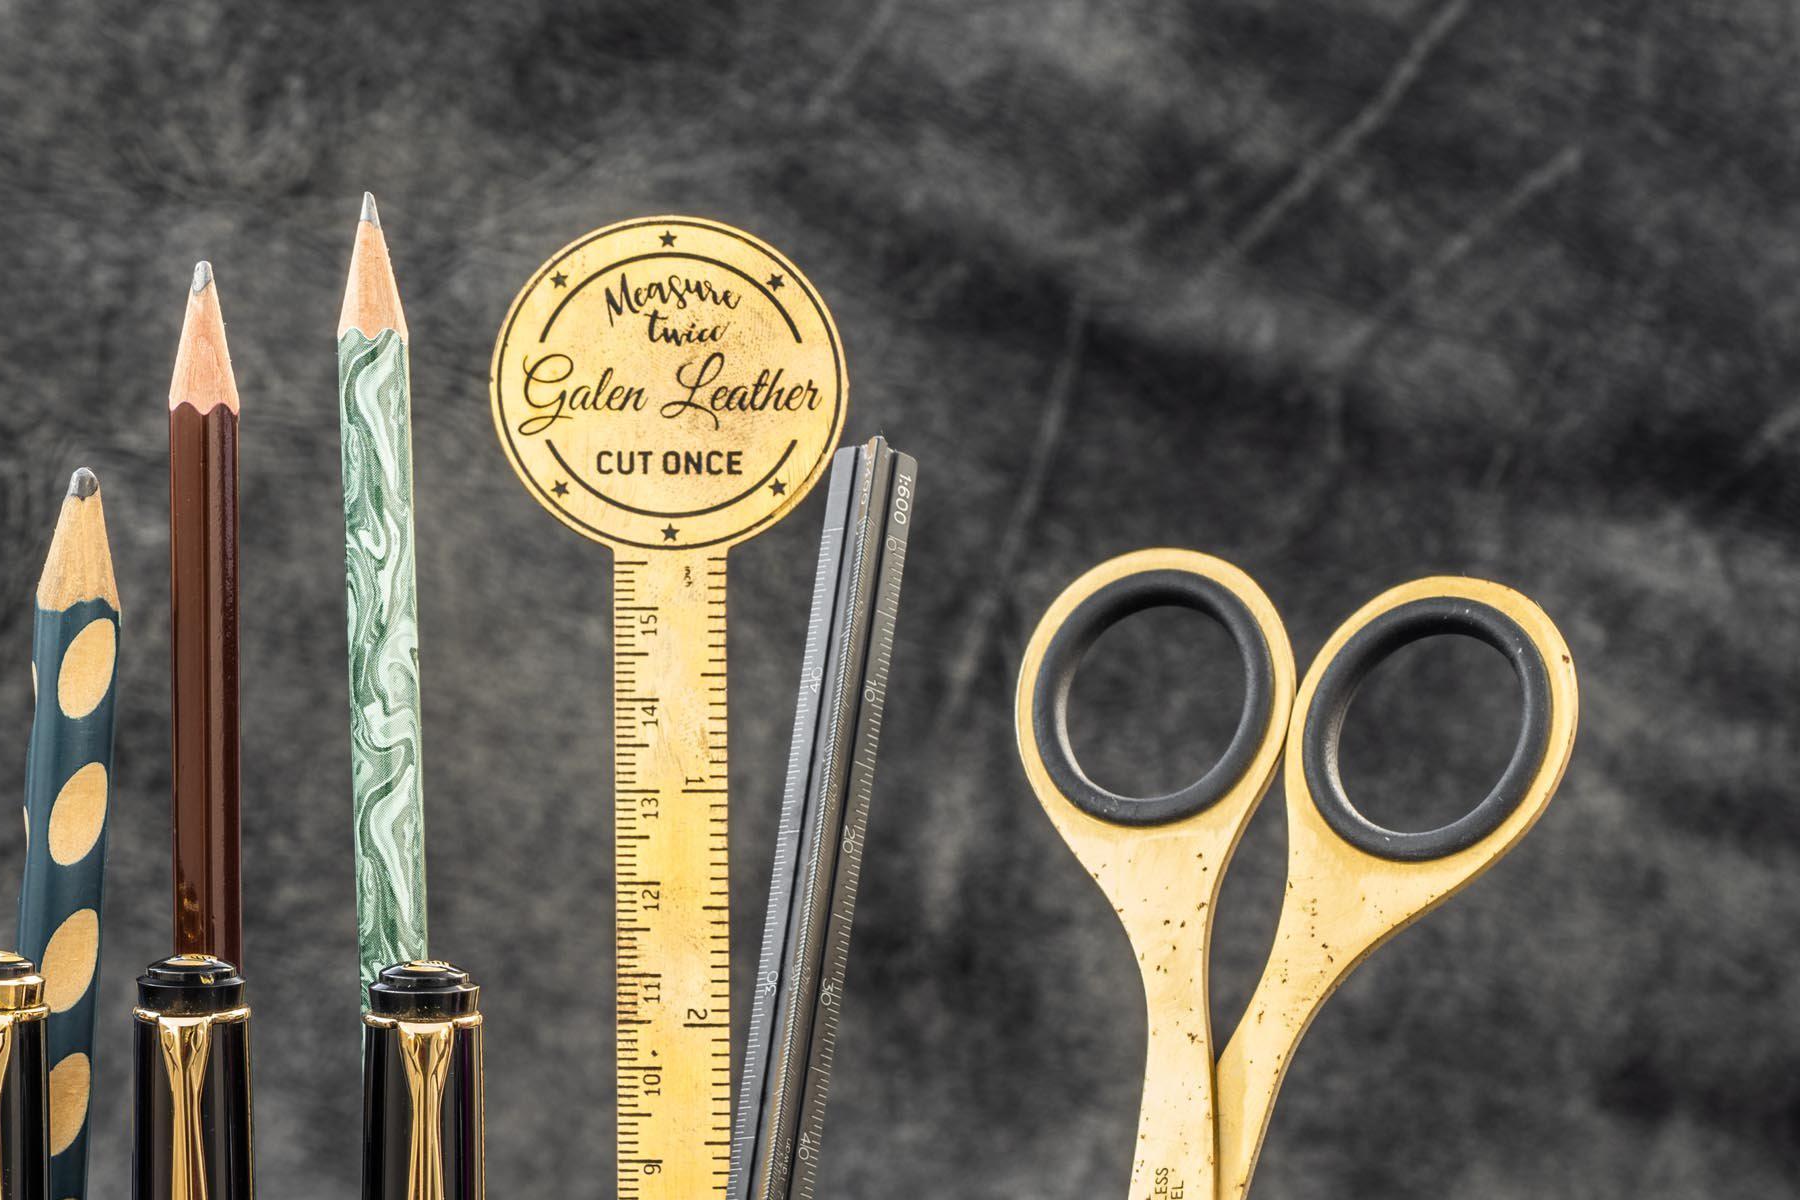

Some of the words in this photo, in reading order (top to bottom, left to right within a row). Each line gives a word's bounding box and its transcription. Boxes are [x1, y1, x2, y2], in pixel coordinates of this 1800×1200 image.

[604, 272, 742, 328] Measure
[643, 309, 731, 347] twice
[517, 353, 649, 437] Galen
[660, 351, 822, 431] Leather
[596, 450, 653, 475] CUT
[662, 450, 743, 475] ONCE
[639, 614, 658, 636] 15
[641, 704, 659, 727] 14
[685, 776, 706, 785] 1
[640, 797, 659, 820] 13
[641, 889, 660, 911] 12
[643, 982, 660, 1003] 11
[687, 1008, 708, 1020] 2
[642, 1073, 661, 1096] 10
[643, 1163, 662, 1175] 9
